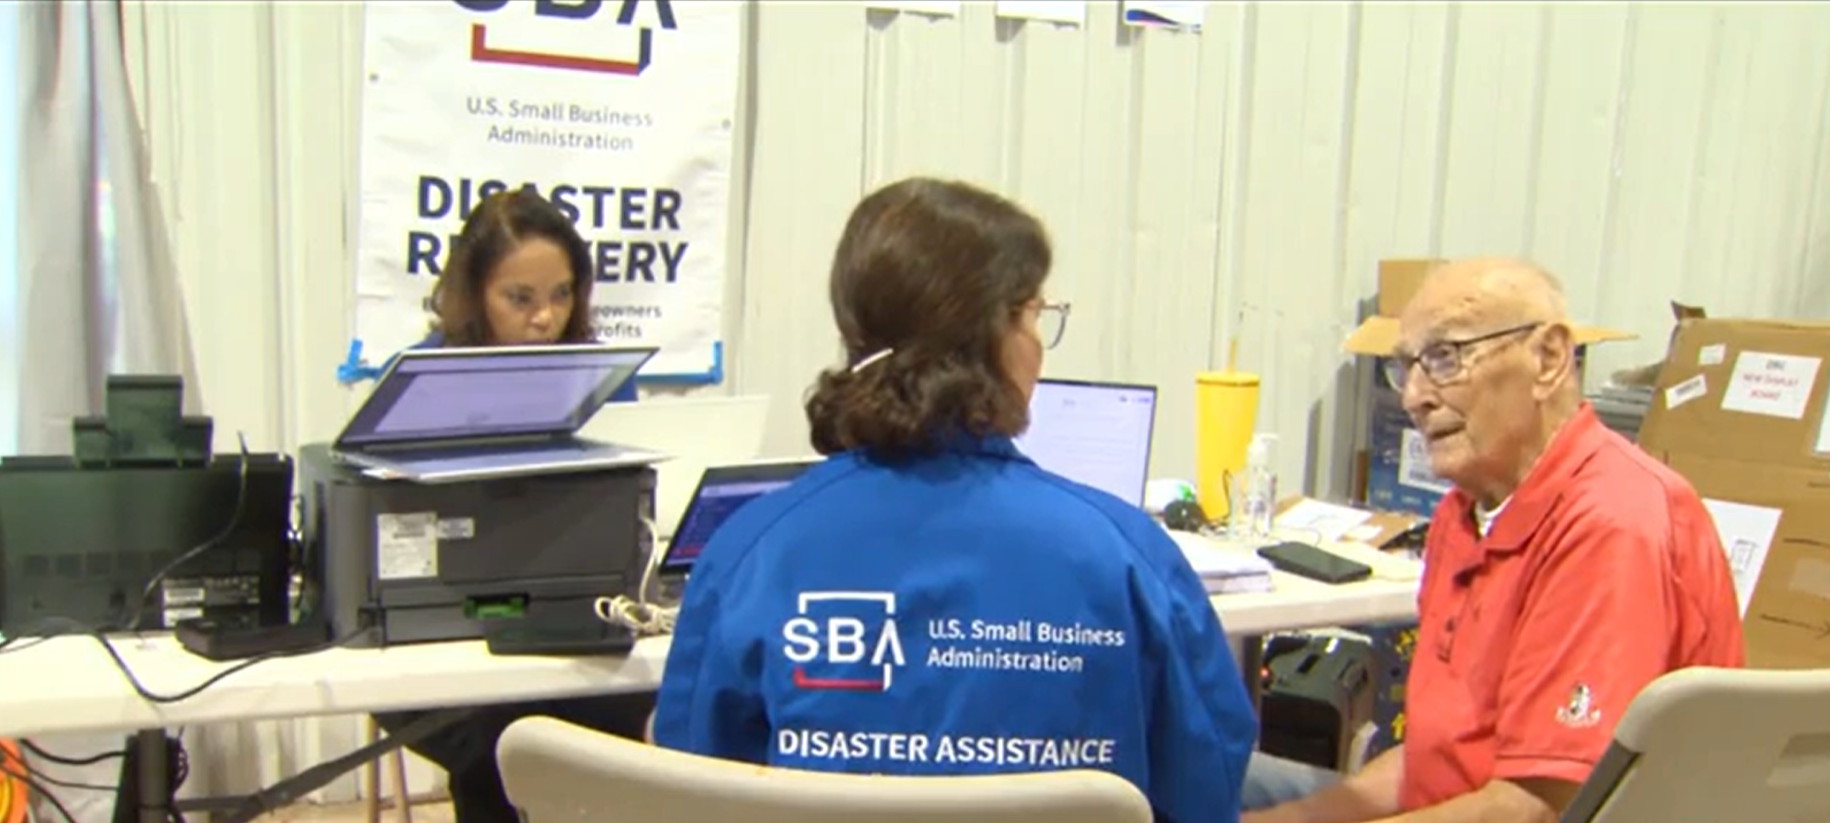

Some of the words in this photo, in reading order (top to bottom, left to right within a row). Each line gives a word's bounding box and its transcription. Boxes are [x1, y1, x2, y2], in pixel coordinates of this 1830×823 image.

[466, 97, 503, 117] U.S.
[509, 99, 564, 122] Small
[568, 103, 654, 127] Business
[487, 125, 634, 151] Administration
[418, 175, 682, 231] DISTER
[407, 230, 689, 283] RERY
[782, 617, 905, 666] SBA
[928, 619, 966, 641] U.S.
[970, 620, 1032, 643] Small
[1037, 624, 1125, 647] Business
[926, 647, 1084, 673] Administration
[777, 728, 929, 762] DISASTER
[934, 736, 1116, 766] ASSISTANCE
